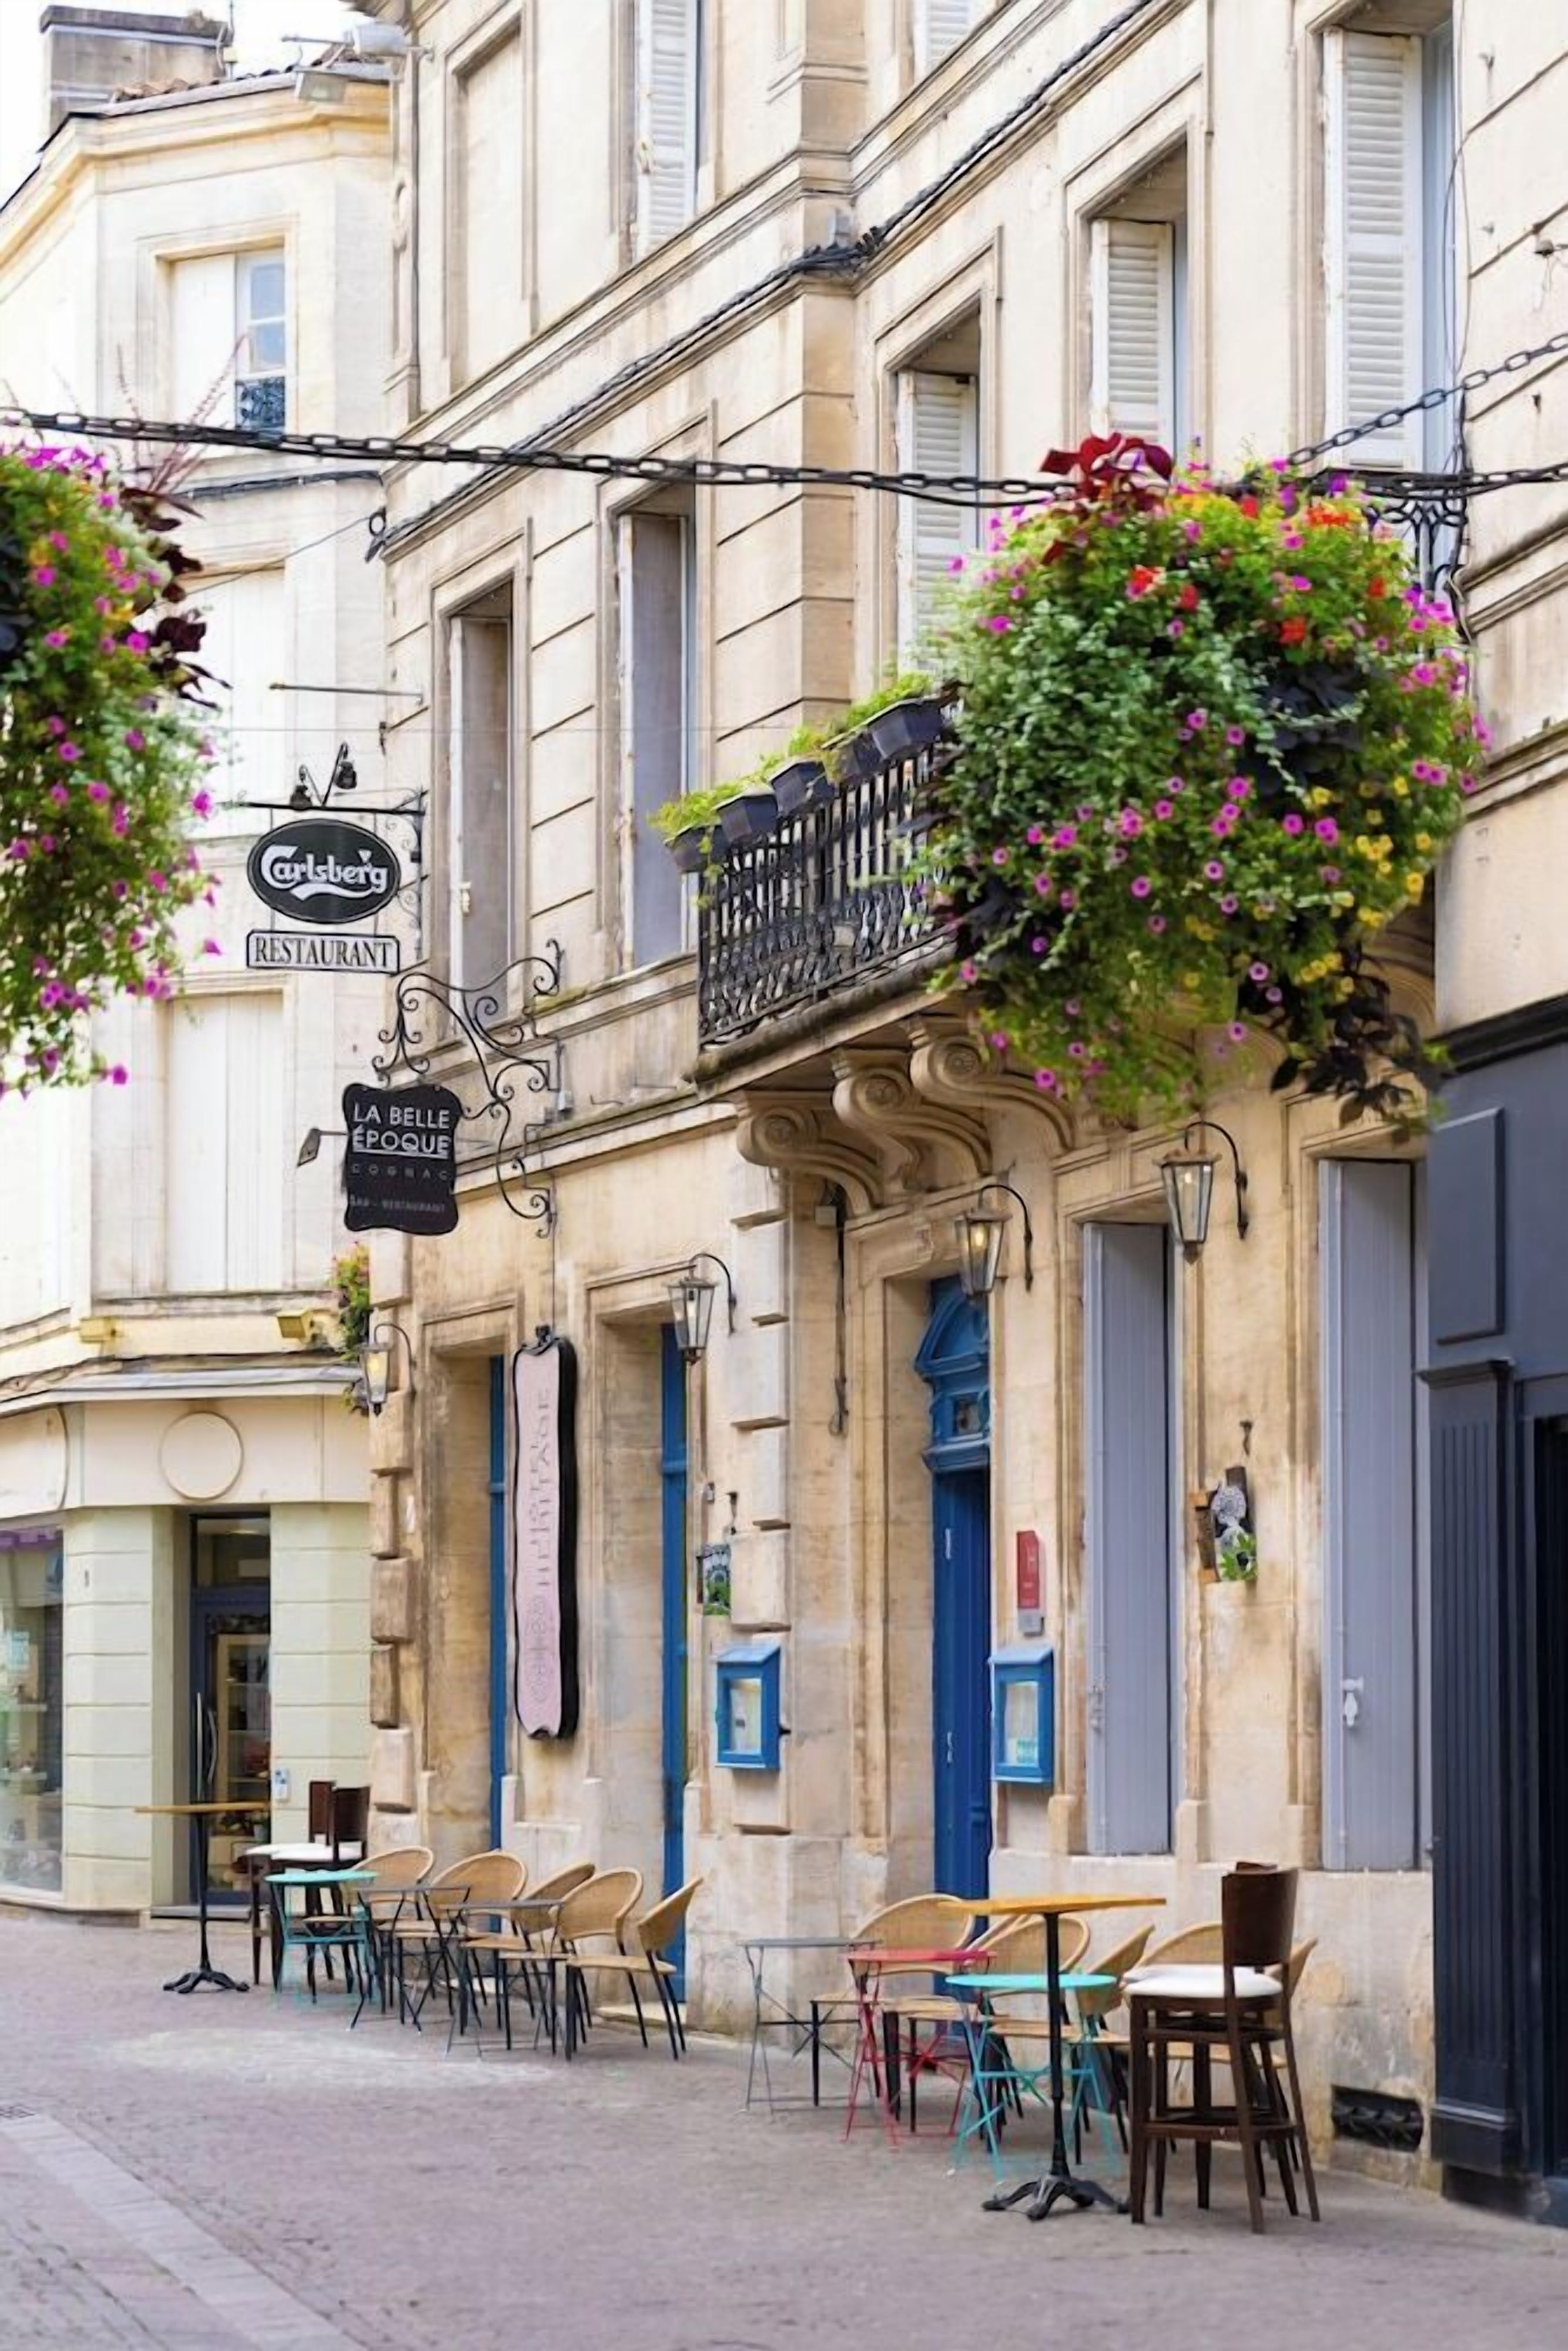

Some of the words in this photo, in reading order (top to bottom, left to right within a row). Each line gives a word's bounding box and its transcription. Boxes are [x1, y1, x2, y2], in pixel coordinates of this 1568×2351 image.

[261, 845, 388, 894] Carlsberg
[255, 936, 392, 967] RESTAURANT
[353, 1102, 381, 1124] LA
[389, 1106, 450, 1128] BELLE
[353, 1124, 451, 1156] ÉPOQUE
